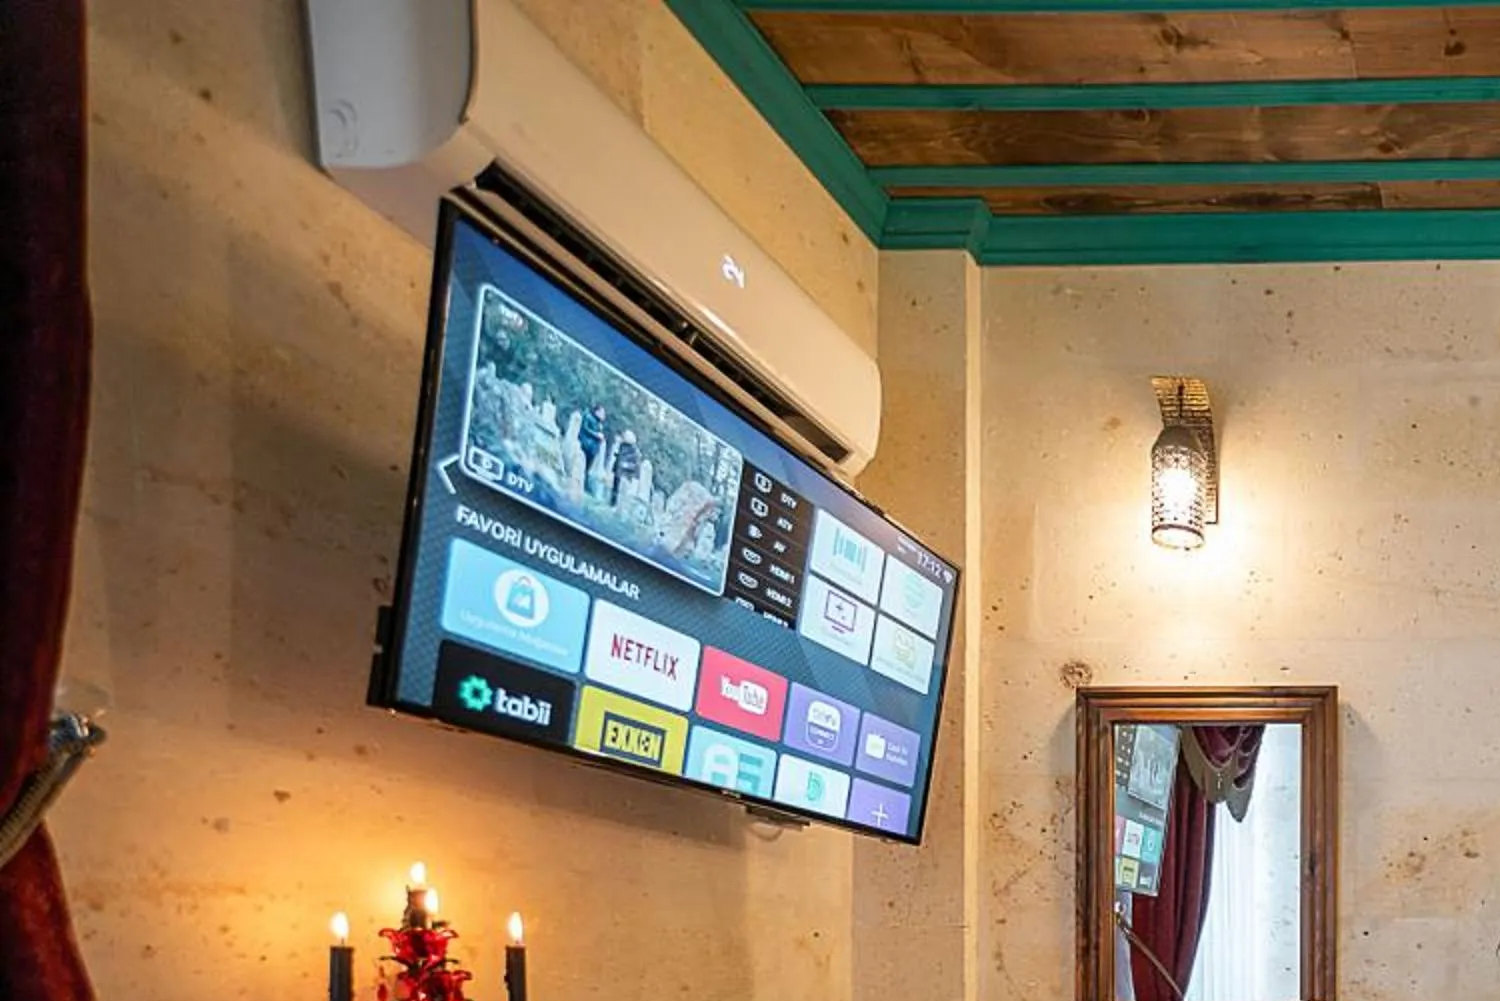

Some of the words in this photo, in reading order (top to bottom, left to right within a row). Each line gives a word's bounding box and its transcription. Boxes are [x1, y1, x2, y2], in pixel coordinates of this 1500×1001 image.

[507, 472, 534, 493] DTV
[455, 504, 521, 547] FAVORİ
[523, 536, 641, 600] UYGULAMALAR
[610, 633, 679, 681] NETFLIX
[494, 687, 552, 727] tabii
[720, 675, 767, 713] YouTube
